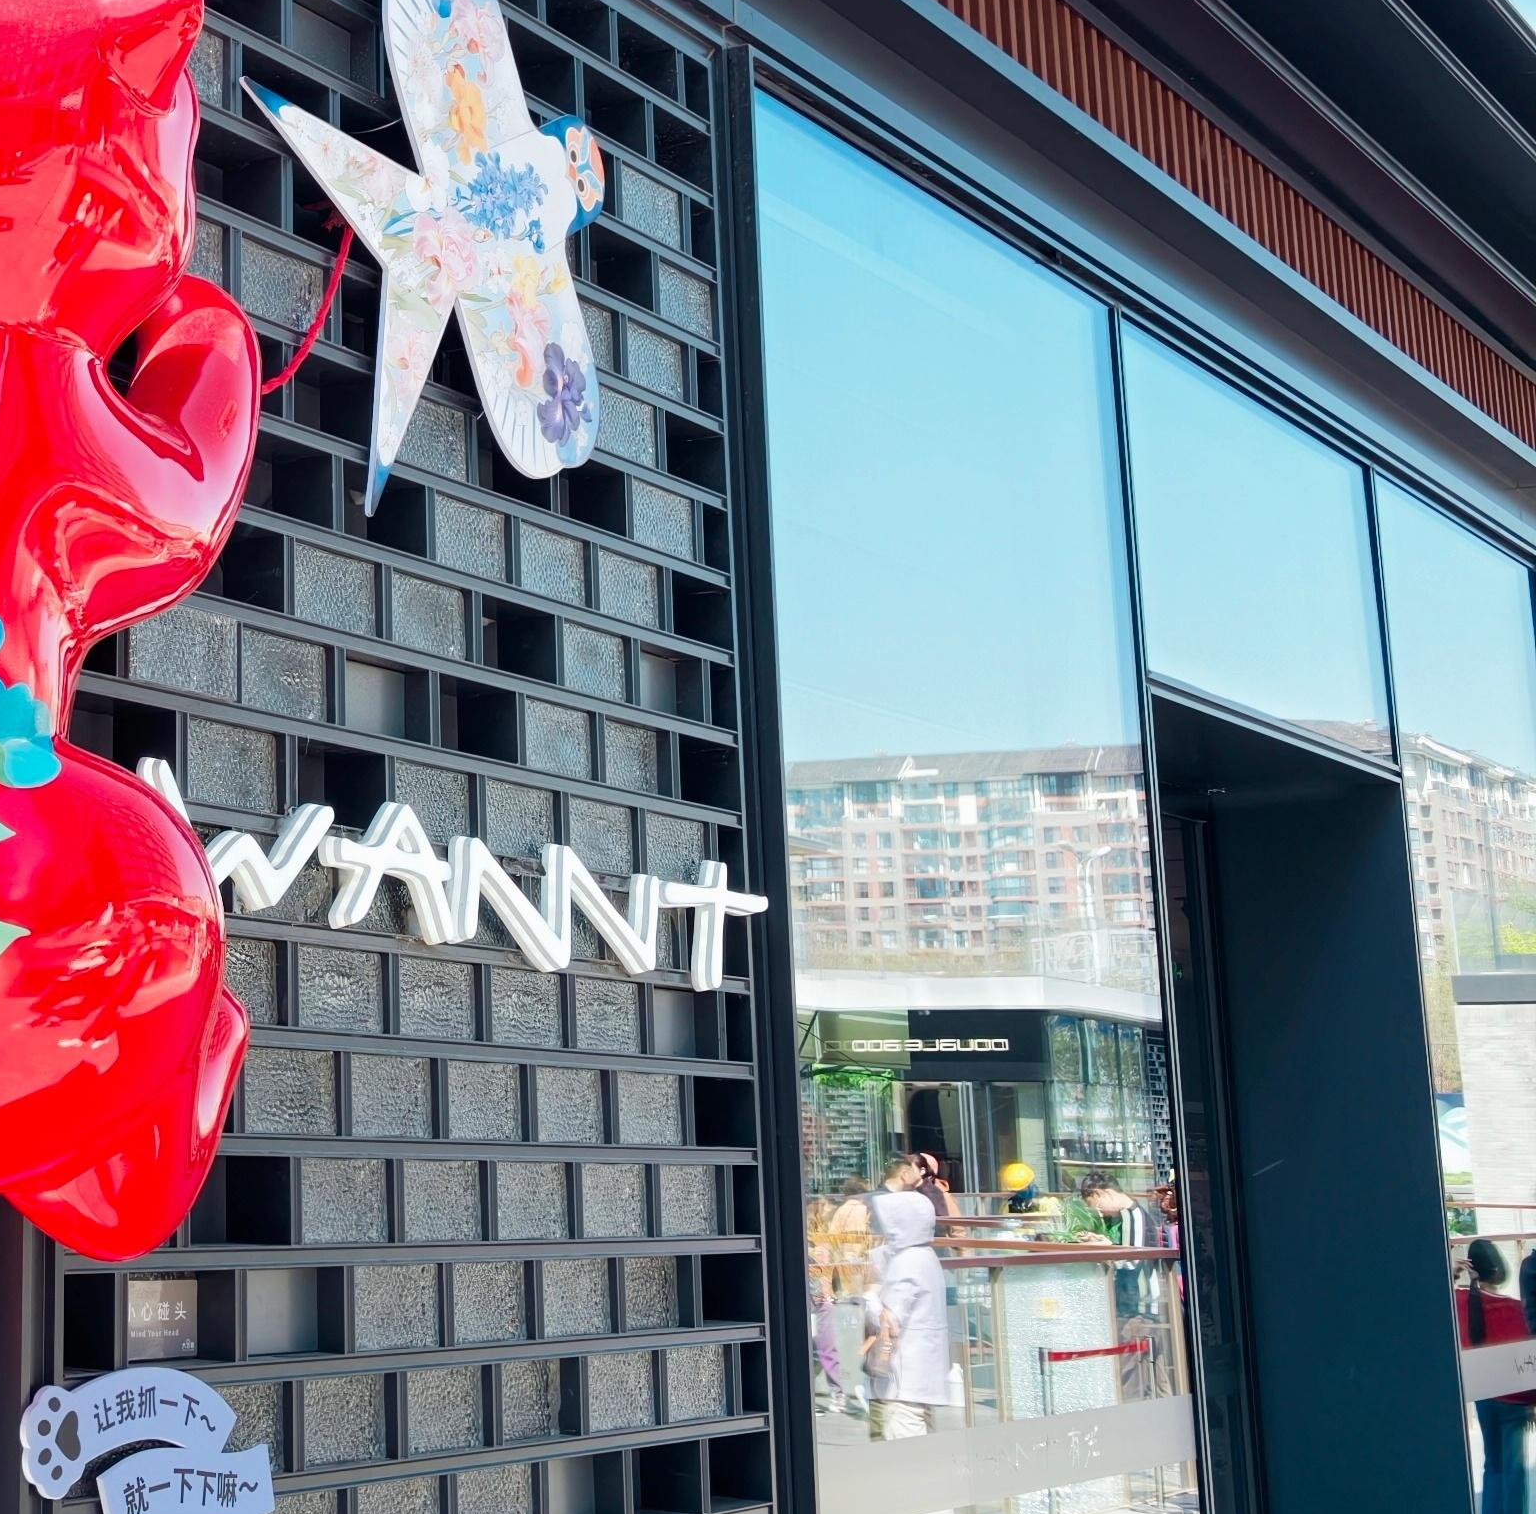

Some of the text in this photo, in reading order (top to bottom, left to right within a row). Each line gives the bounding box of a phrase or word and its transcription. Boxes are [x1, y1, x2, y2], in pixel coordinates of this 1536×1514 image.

[131, 1328, 180, 1338] Mind Your Head
